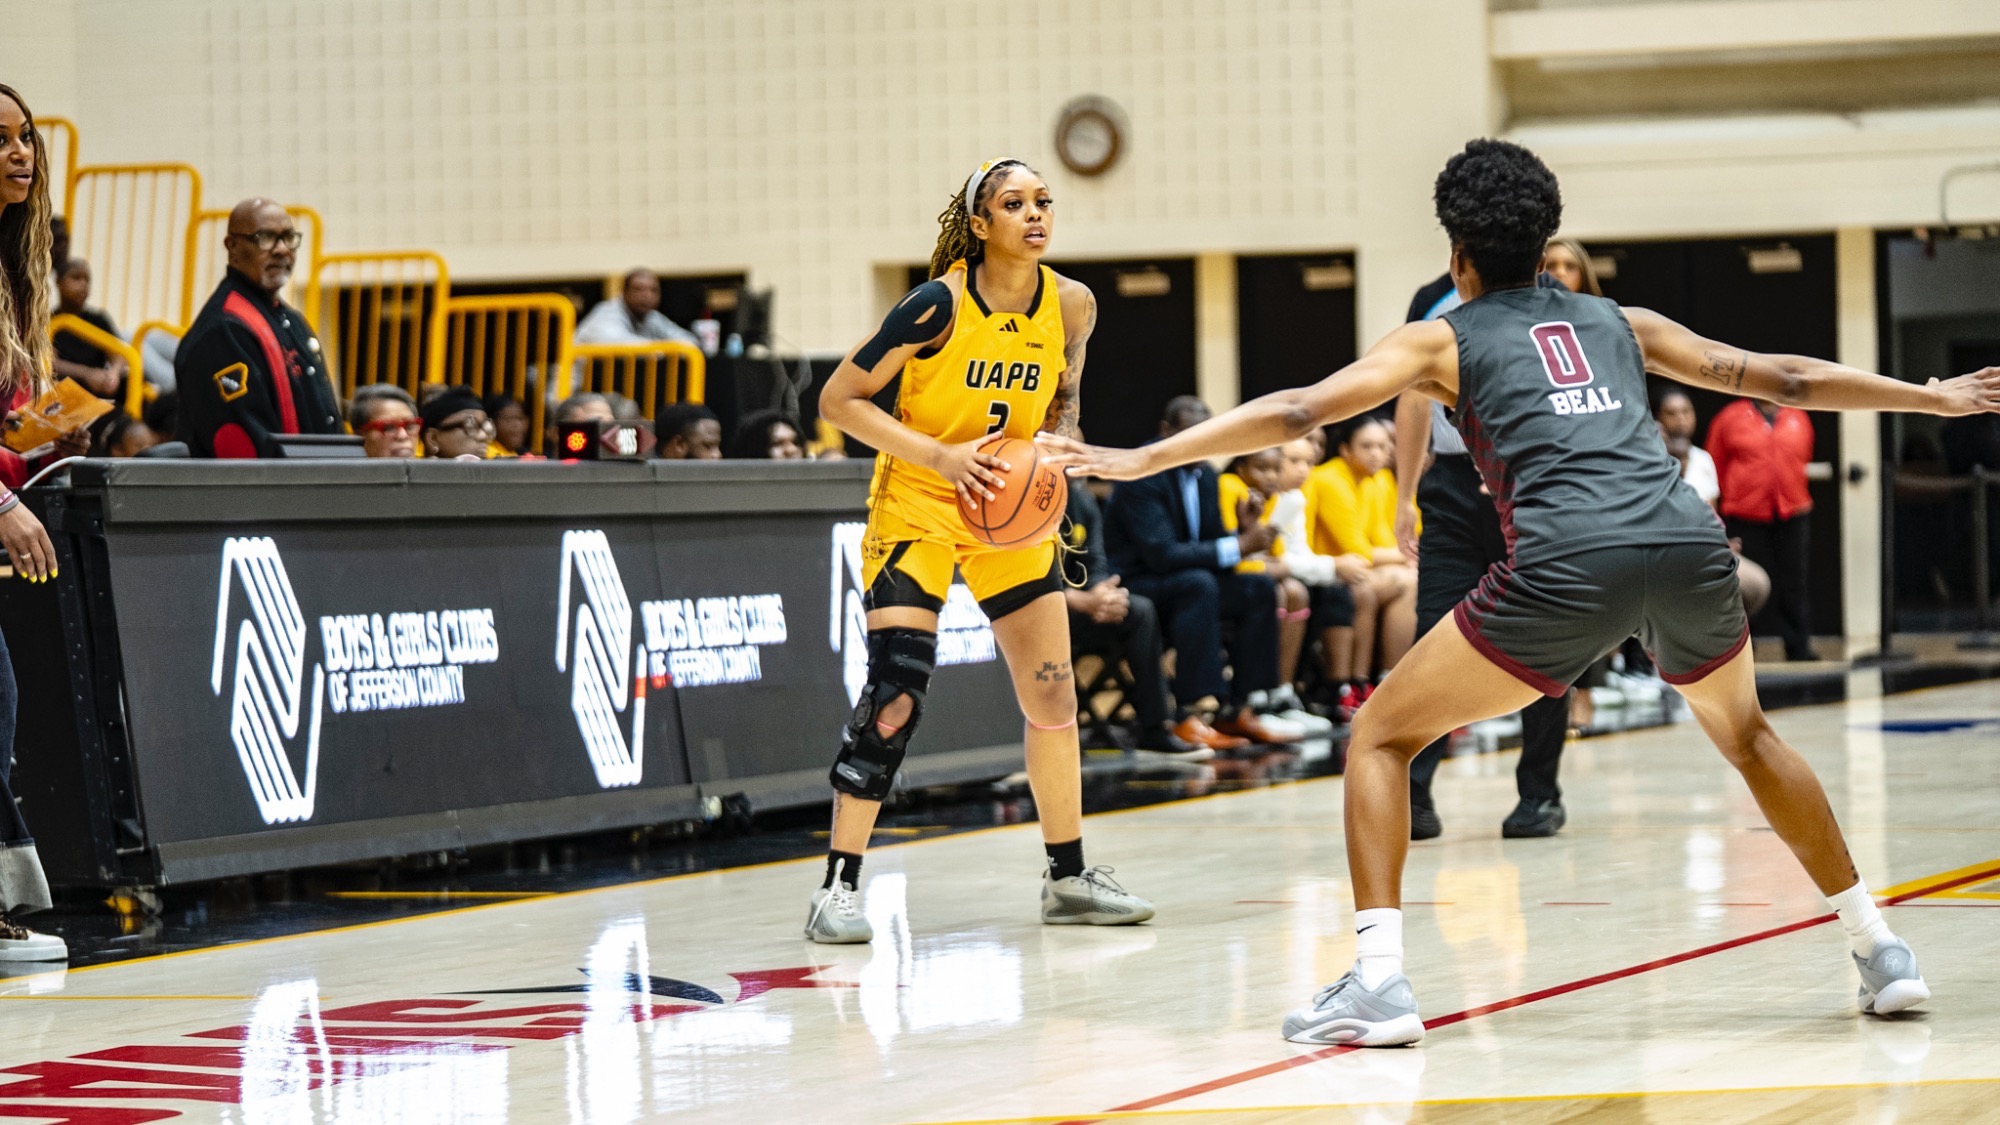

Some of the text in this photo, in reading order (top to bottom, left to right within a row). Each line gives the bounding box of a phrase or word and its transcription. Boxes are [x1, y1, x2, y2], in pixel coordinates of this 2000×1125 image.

[965, 358, 1041, 392] UAPB
[1529, 321, 1594, 388] 0
[1548, 387, 1622, 415] BEAL
[1038, 472, 1057, 511] PRO
[319, 608, 499, 672] BOYS & GIRLS CLUBS
[328, 664, 465, 714] OF JEFFERSON COUNTY
